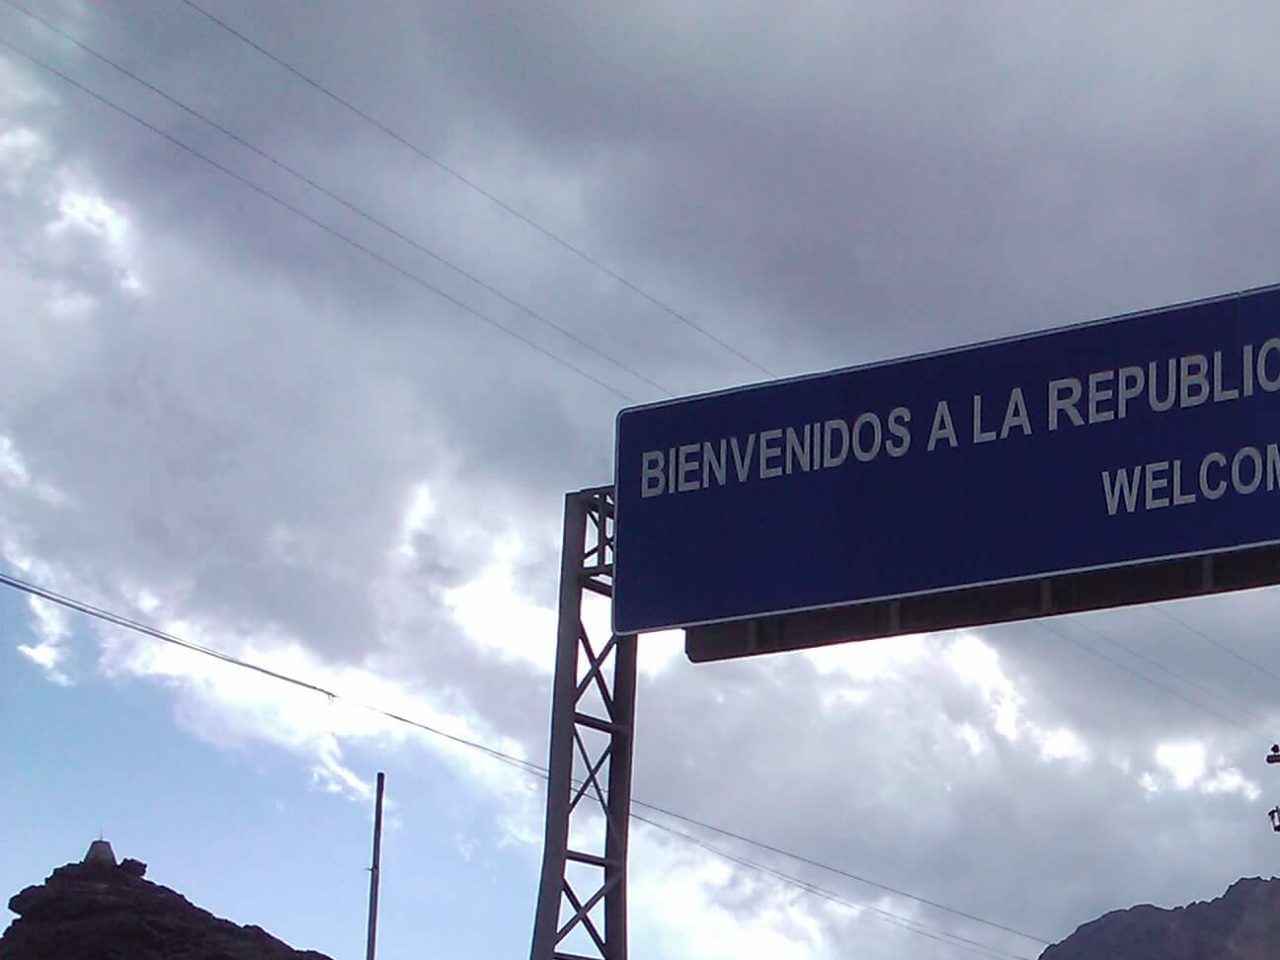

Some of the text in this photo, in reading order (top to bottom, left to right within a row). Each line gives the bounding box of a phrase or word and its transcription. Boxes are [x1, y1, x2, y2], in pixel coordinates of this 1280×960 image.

[641, 407, 911, 498] BIENVENIDOS
[927, 401, 960, 451] A
[973, 388, 1033, 443] LA
